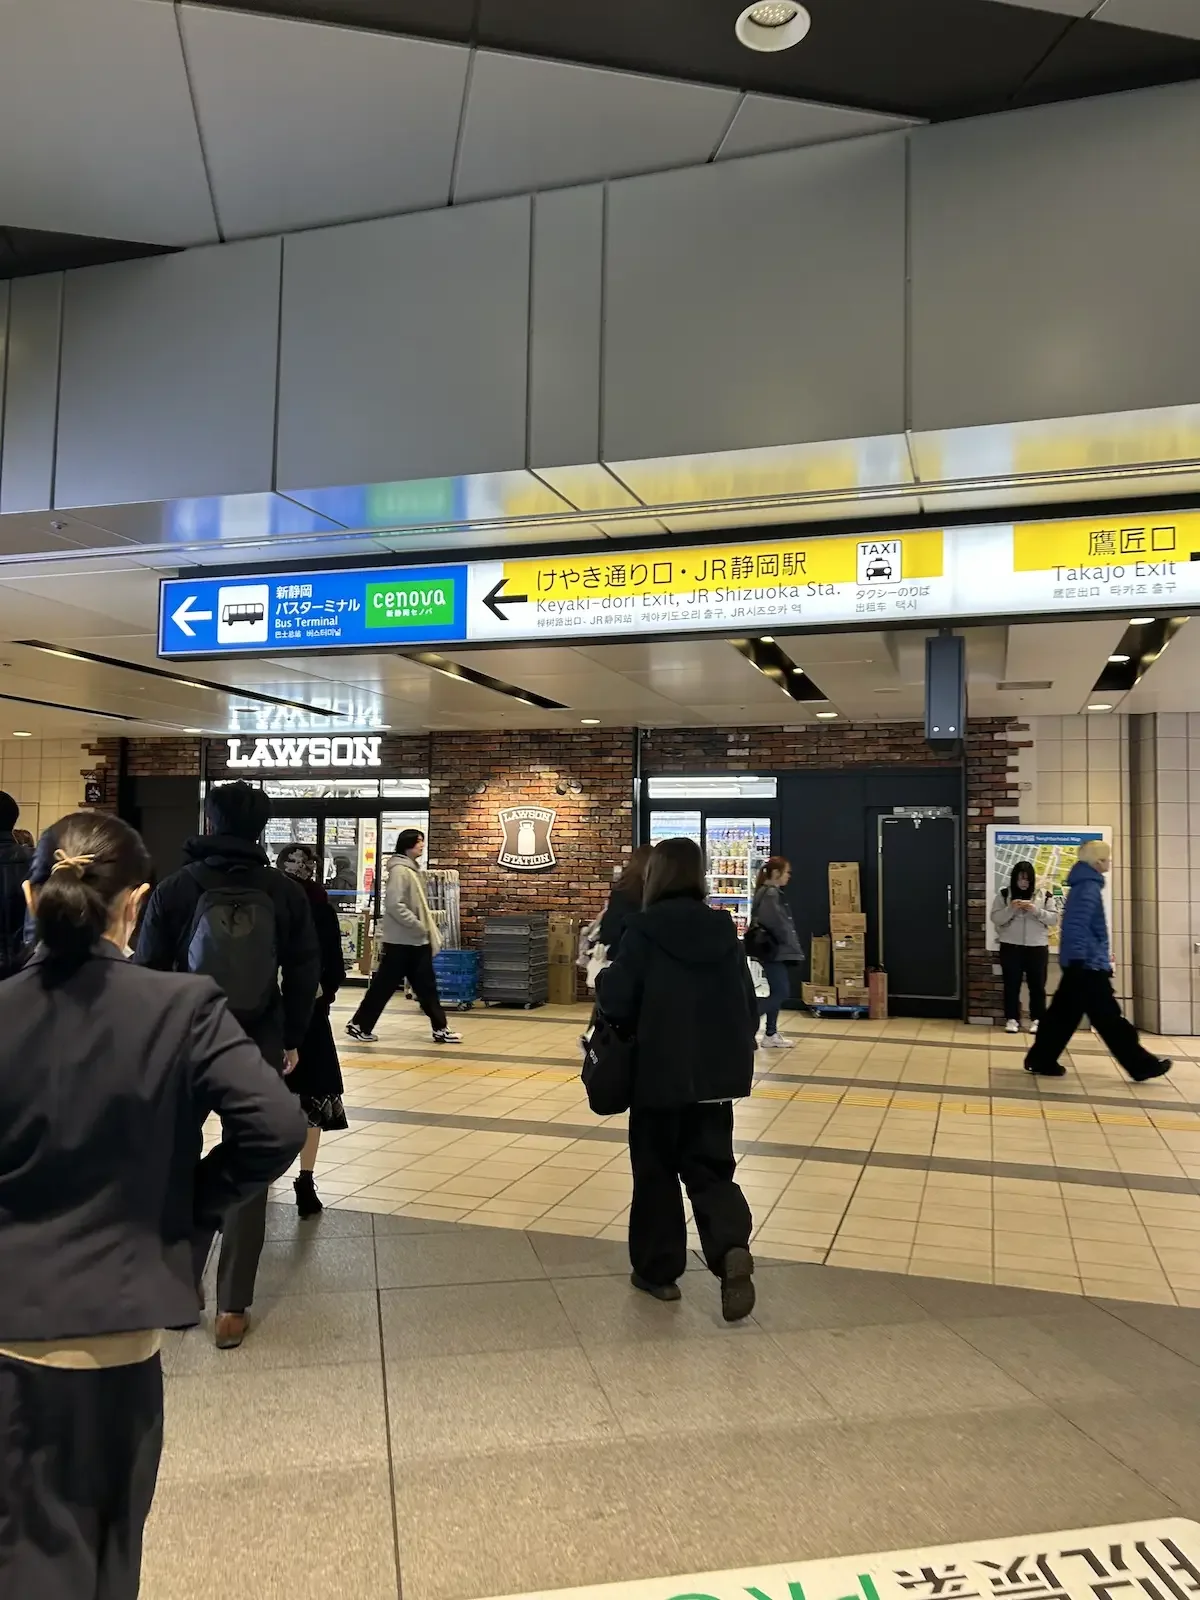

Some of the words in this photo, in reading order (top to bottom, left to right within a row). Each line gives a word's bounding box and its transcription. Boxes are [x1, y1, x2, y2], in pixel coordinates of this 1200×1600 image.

[860, 543, 896, 555] TAXI
[1088, 527, 1176, 556] 鷹匠口
[537, 551, 807, 591] けやき通り口・JR静岡駅
[1052, 563, 1125, 583] Takajo
[1135, 560, 1176, 577] Exit
[276, 584, 313, 599] 新静岡
[856, 586, 930, 599] タクシーのりば
[1152, 582, 1177, 594] 출구
[373, 589, 447, 608] cenova
[536, 593, 635, 614] Keyaki-dori
[643, 590, 680, 608] Exit,
[687, 588, 709, 604] JR
[715, 583, 799, 603] Shizuoka
[806, 581, 841, 597] Sta.
[896, 600, 917, 610] 택시
[275, 598, 361, 615] バスターミナル
[731, 603, 788, 618] JR시즈오카
[791, 604, 802, 614] 역
[275, 618, 292, 628] Bus
[295, 615, 338, 628] Terminal
[226, 737, 382, 767] LAWSON
[502, 810, 552, 822] LAWSON
[502, 853, 551, 865] STATION
